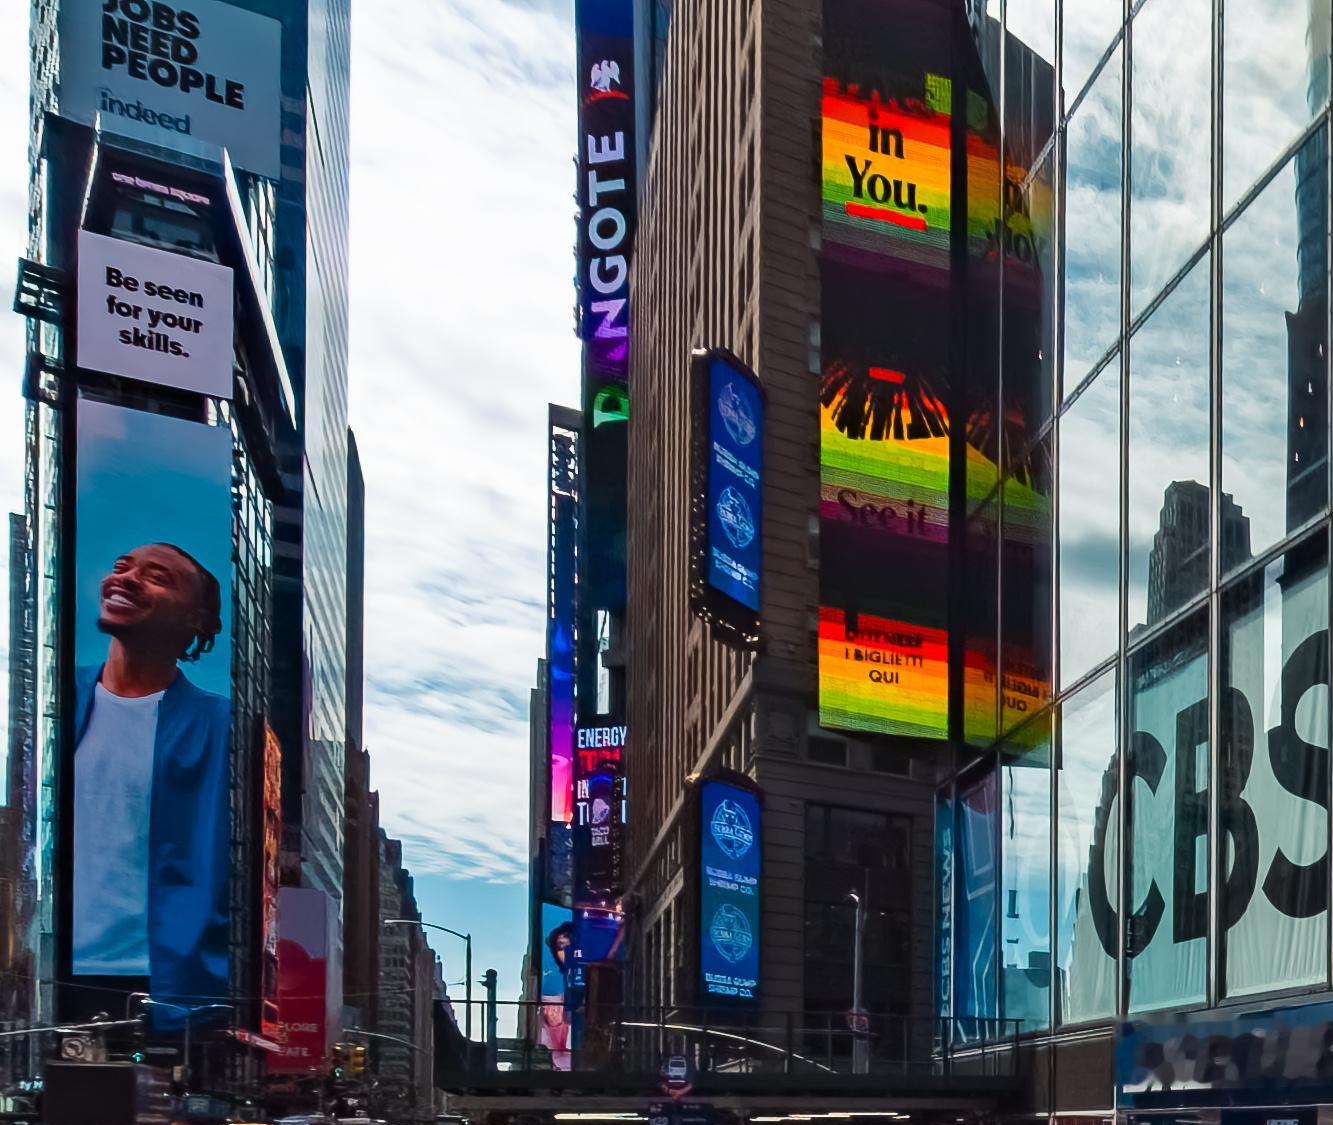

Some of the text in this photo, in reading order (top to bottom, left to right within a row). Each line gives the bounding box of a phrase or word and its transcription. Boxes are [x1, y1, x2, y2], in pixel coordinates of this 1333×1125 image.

[102, 0, 200, 39] JOBS
[102, 13, 198, 65] NEED
[102, 42, 245, 110] PEOPLE
[100, 90, 192, 136] indeed
[868, 111, 905, 160] in
[845, 154, 928, 215] You.
[106, 266, 204, 308] Be seen
[106, 295, 203, 334] for your
[119, 327, 190, 358] skills.
[837, 489, 897, 530] See
[854, 648, 923, 668] BIGLIETTI
[868, 669, 899, 684] QUI
[577, 726, 627, 749] ENERGY
